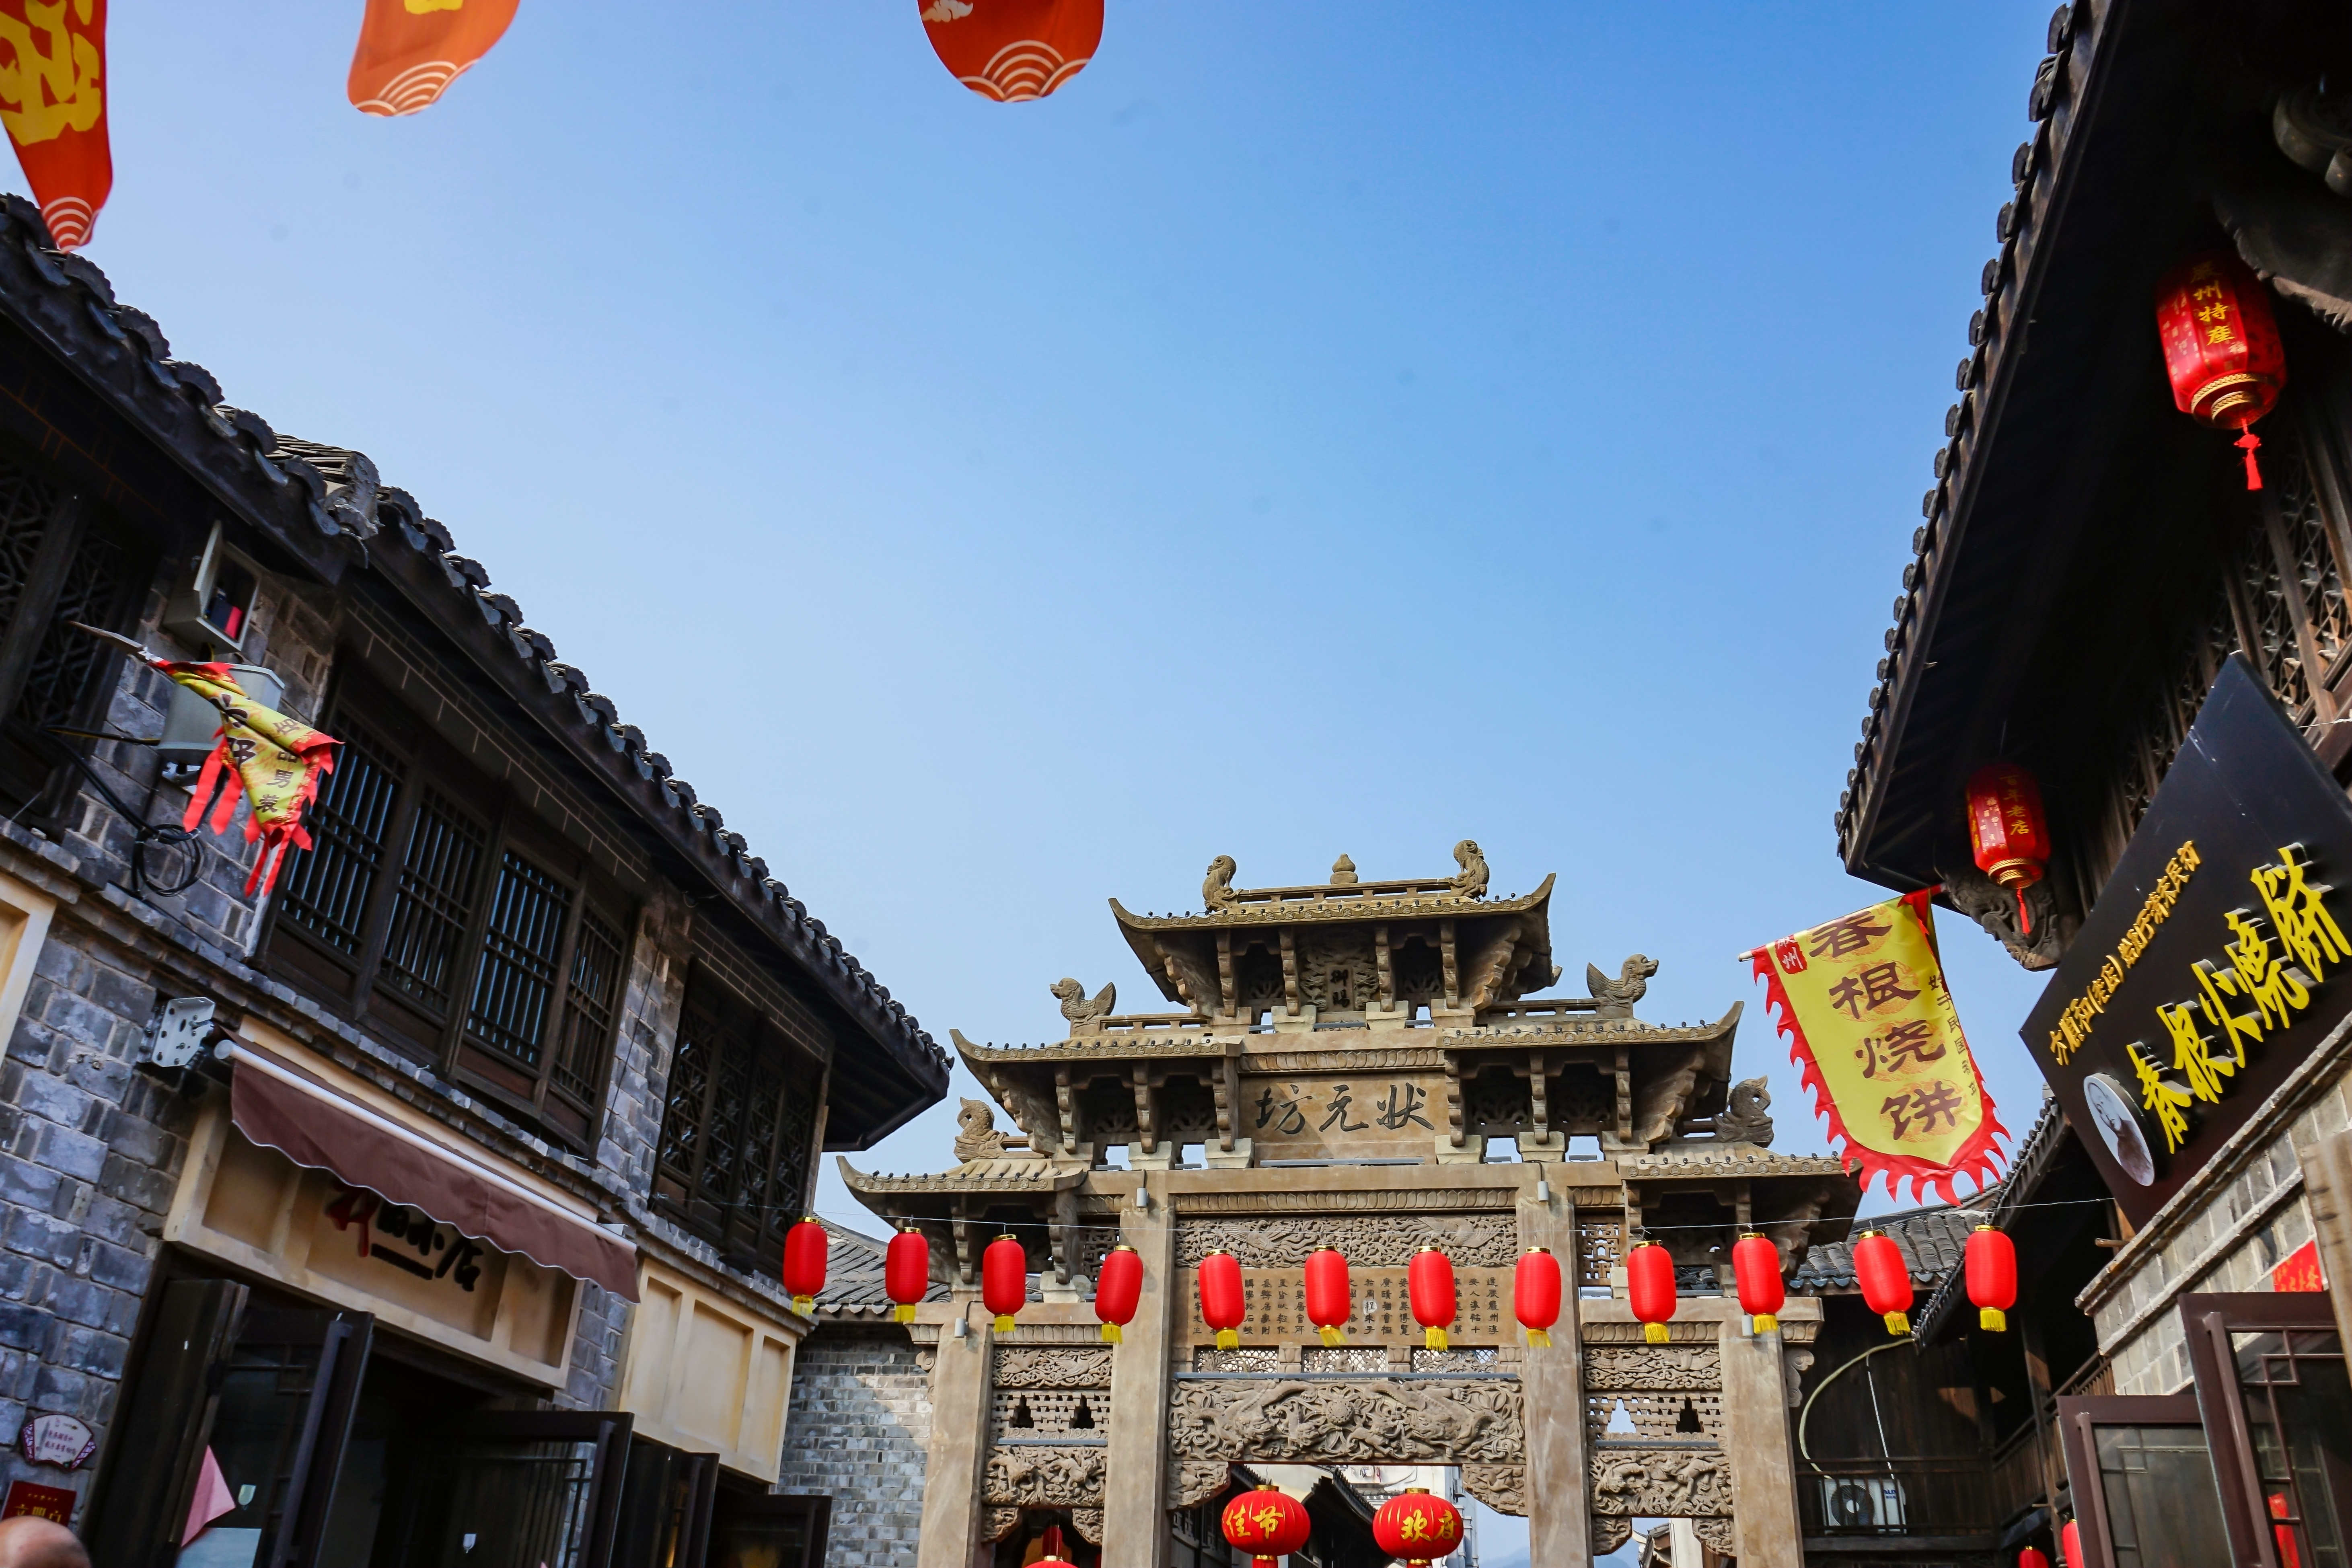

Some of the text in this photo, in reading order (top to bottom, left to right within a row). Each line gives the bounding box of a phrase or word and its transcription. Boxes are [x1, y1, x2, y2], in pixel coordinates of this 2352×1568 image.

[1999, 775, 2029, 836] 百年老店
[1809, 908, 1962, 1141] 春根烧饼
[1226, 1504, 1283, 1539] 佳节
[1401, 1509, 1459, 1543] 欢度
